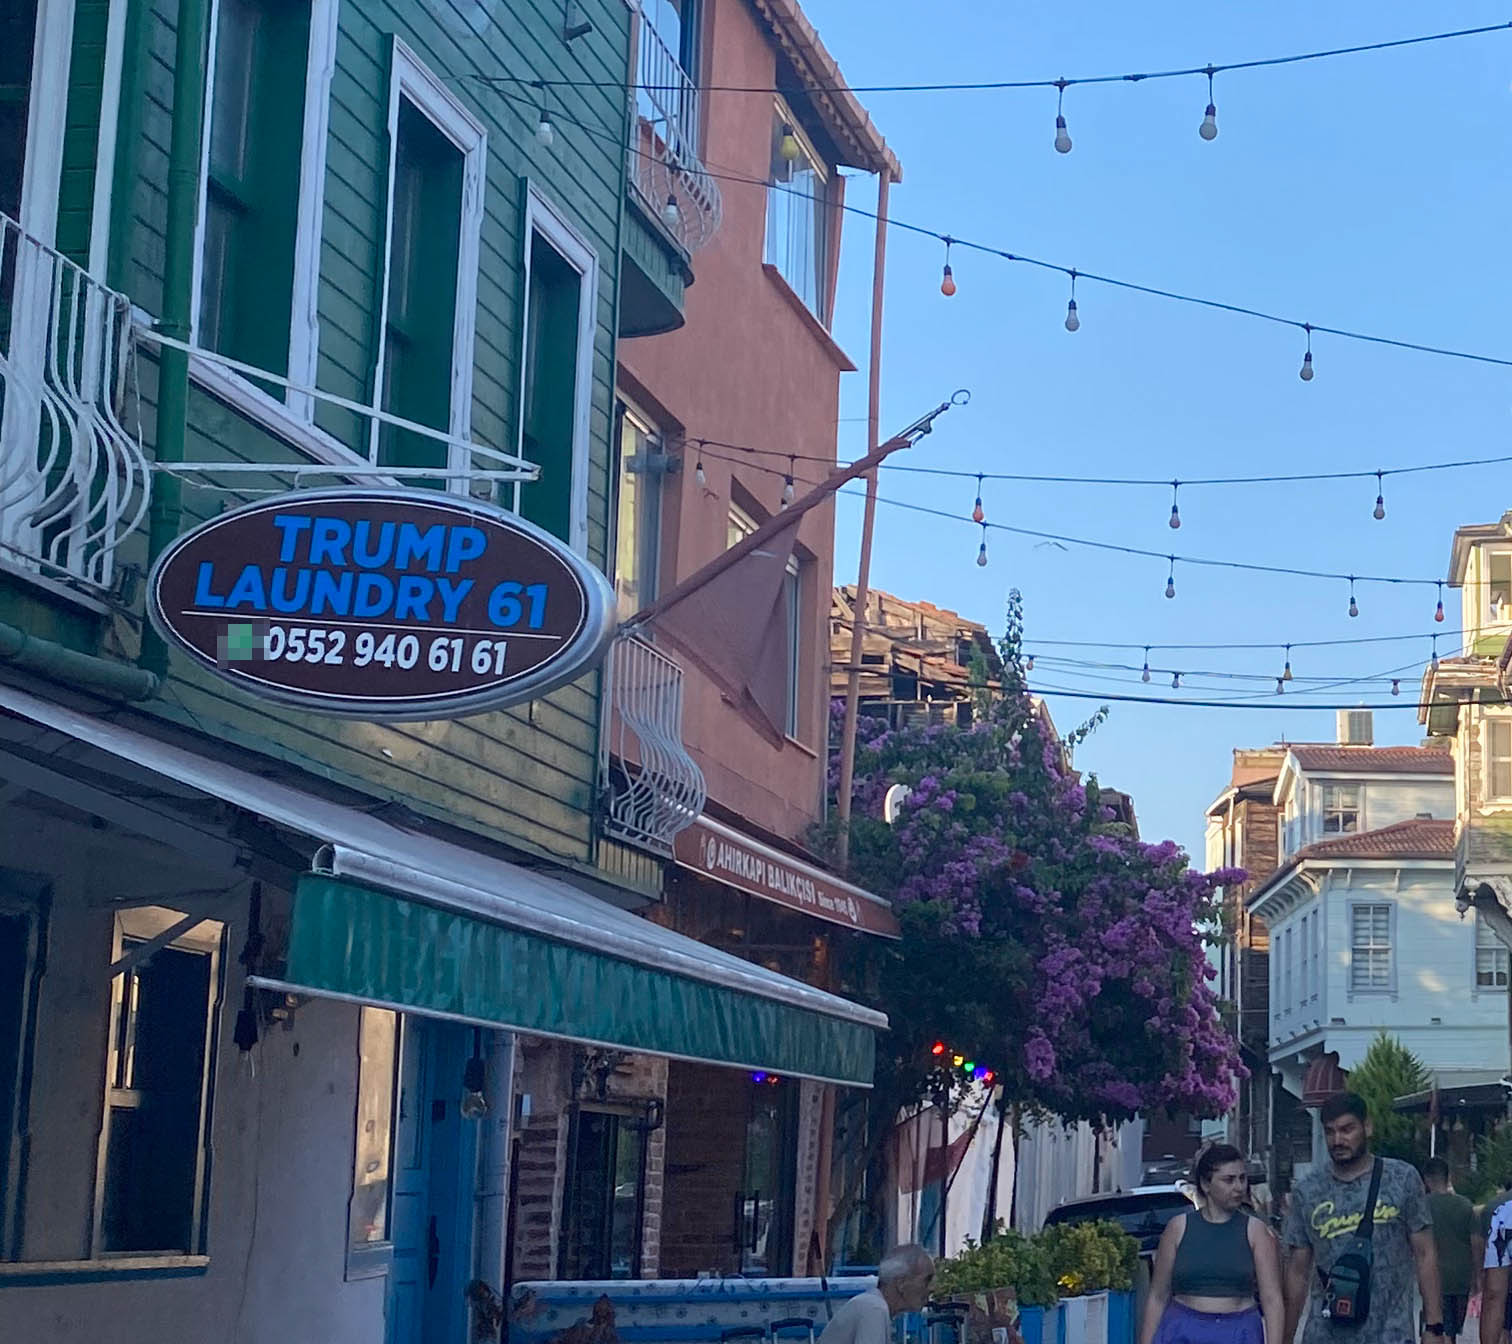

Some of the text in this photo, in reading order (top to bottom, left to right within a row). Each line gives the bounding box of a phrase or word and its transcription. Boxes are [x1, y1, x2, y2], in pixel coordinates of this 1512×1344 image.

[273, 514, 489, 574] TRUMP
[194, 561, 549, 629] LAUNDRY 61
[268, 626, 507, 676] 0552 940 61 61
